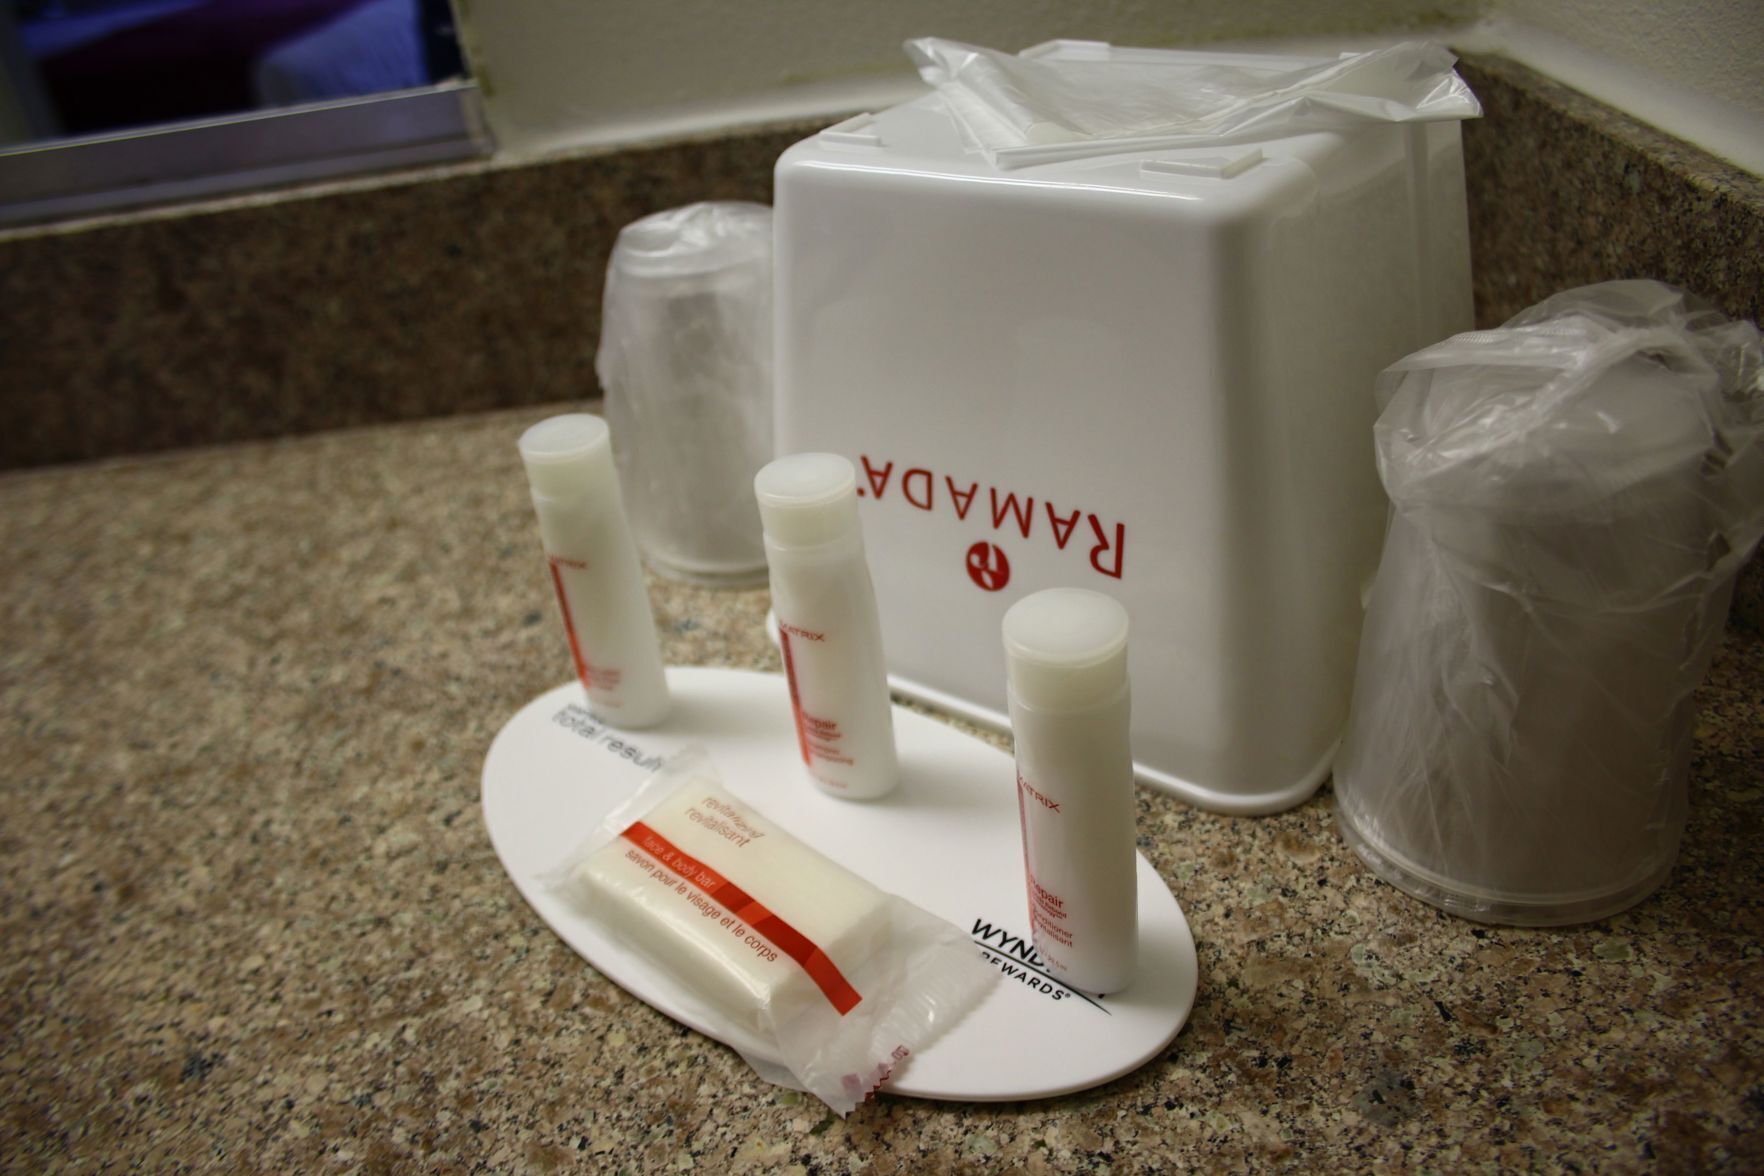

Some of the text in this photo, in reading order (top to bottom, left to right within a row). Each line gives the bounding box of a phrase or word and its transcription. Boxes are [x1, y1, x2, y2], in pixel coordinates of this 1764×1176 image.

[860, 455, 1126, 580] RAMADA
[625, 849, 778, 962] savon pour le visage et le corps
[694, 871, 716, 889] bar
